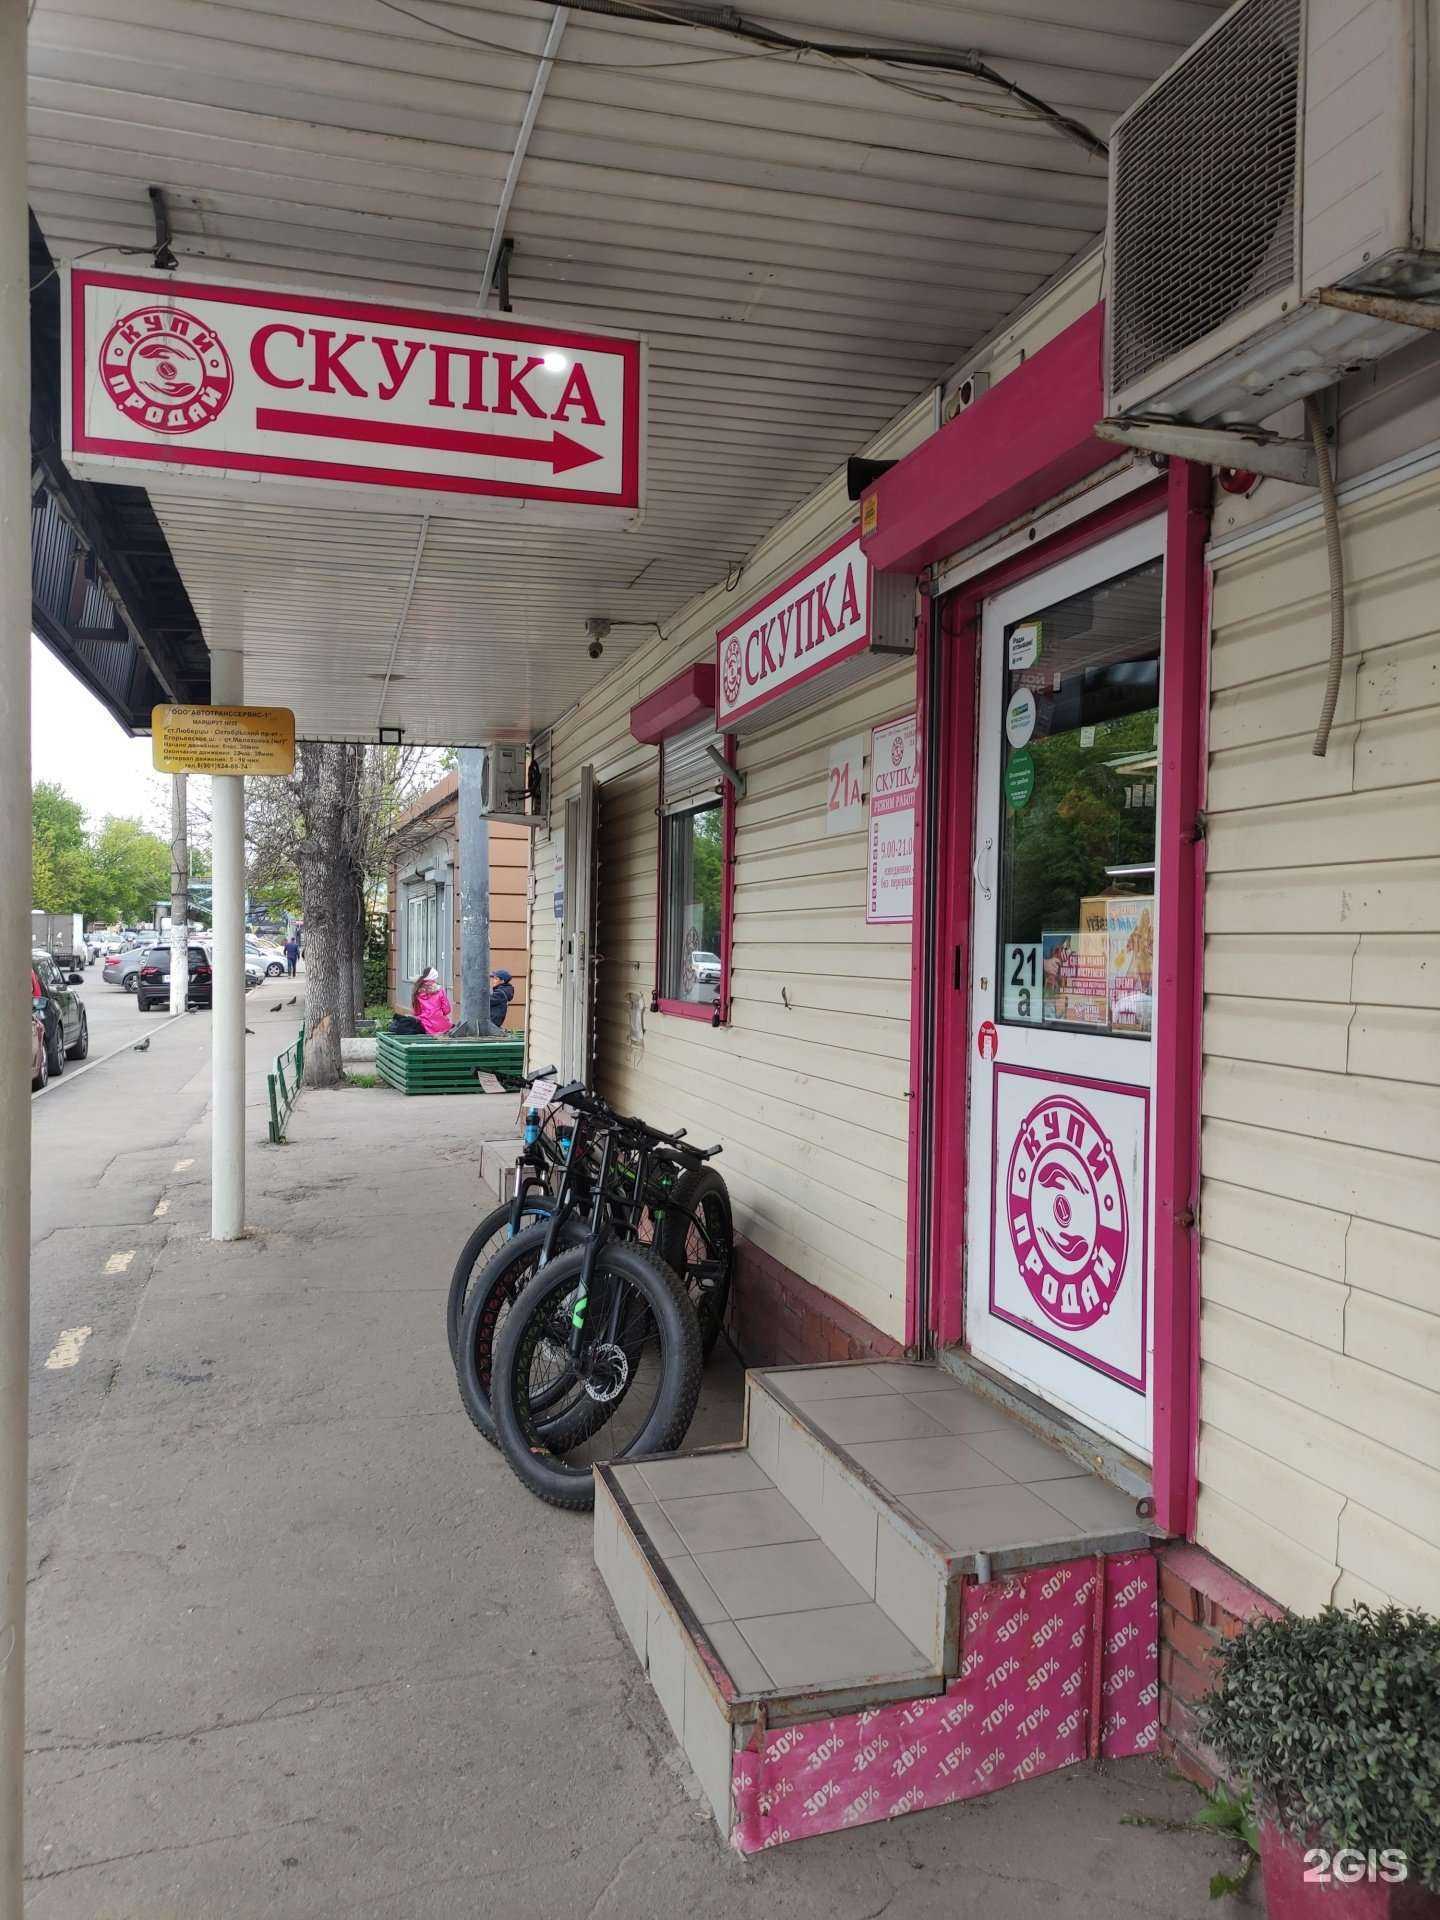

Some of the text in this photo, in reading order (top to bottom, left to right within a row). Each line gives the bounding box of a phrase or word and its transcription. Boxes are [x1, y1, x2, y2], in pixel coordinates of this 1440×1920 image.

[120, 314, 214, 353] КУПИ
[249, 324, 605, 426] СКУПКА
[109, 373, 222, 426] ПРОДАЙ
[745, 562, 861, 686] СКУПКА
[896, 791, 916, 808] РАБОТ
[881, 838, 913, 858] 9.00-21.0
[1010, 947, 1037, 987] 21
[1023, 1111, 1109, 1181] КУПИ
[1013, 1213, 1116, 1313] ПРОДАЙ
[1040, 1570, 1071, 1600] -60%
[1113, 1575, 1148, 1608] -30%
[995, 1608, 1029, 1643] -50%
[1030, 1613, 1063, 1649] -50%
[985, 1657, 1019, 1691] -70%
[1026, 1657, 1059, 1691] -50%
[938, 1699, 974, 1734] -15%
[980, 1699, 1014, 1735] -70%
[1016, 1704, 1049, 1739] -70%
[765, 1727, 804, 1764] -30%
[805, 1733, 844, 1771] -30%
[852, 1734, 889, 1772] -20%
[891, 1740, 928, 1777] -20%
[935, 1742, 972, 1778] -15%
[971, 1747, 1005, 1784] -15%
[1011, 1746, 1046, 1783] -70%
[802, 1780, 840, 1817] -30%
